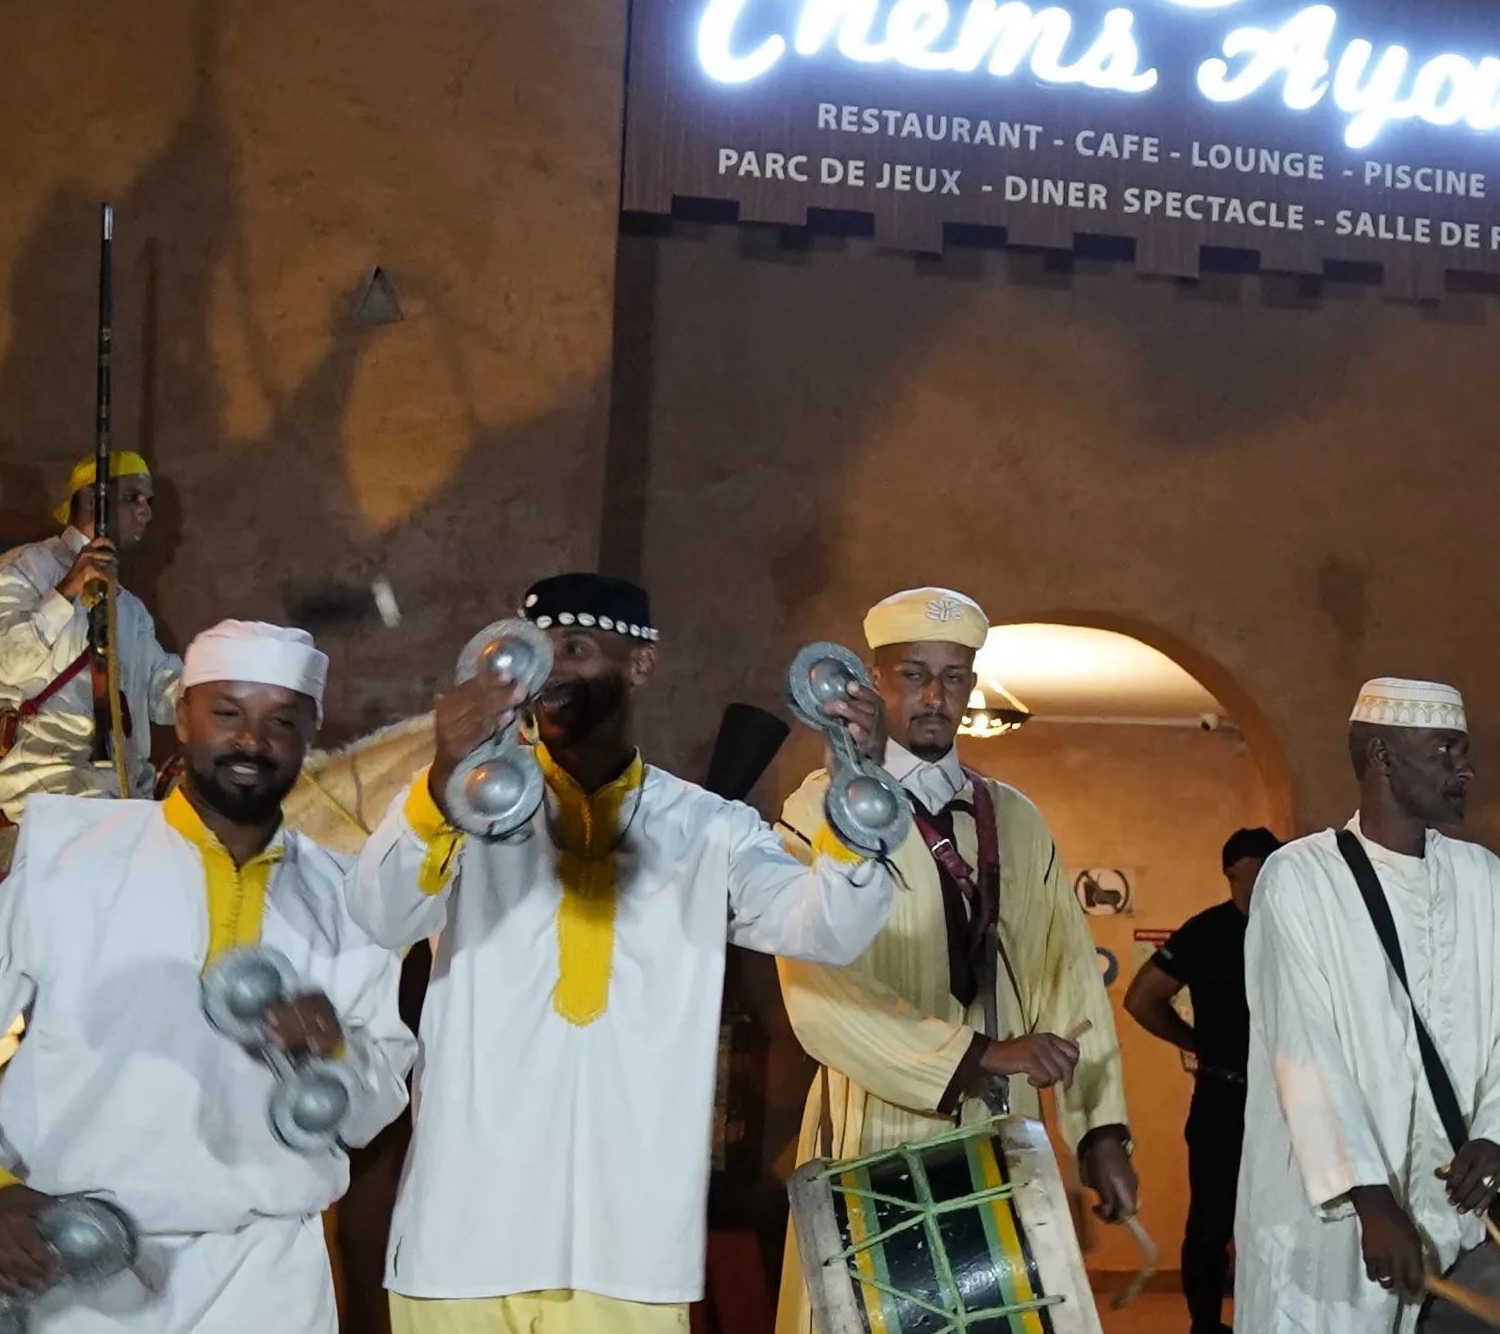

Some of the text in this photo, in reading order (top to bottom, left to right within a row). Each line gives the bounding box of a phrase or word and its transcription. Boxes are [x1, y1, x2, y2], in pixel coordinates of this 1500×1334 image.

[717, 148, 808, 182] PARC
[820, 157, 865, 187] DE
[876, 162, 961, 196] JEUX
[1004, 175, 1108, 210] DINER
[1123, 187, 1304, 231] SPECTACLE
[1335, 209, 1431, 244] SALLE
[1440, 221, 1480, 249] DE
[817, 102, 1043, 150] RESTAURANT
[1075, 130, 1160, 163] CAFE
[1191, 141, 1325, 180] LOUNGE
[1364, 161, 1487, 198] PISCINE
